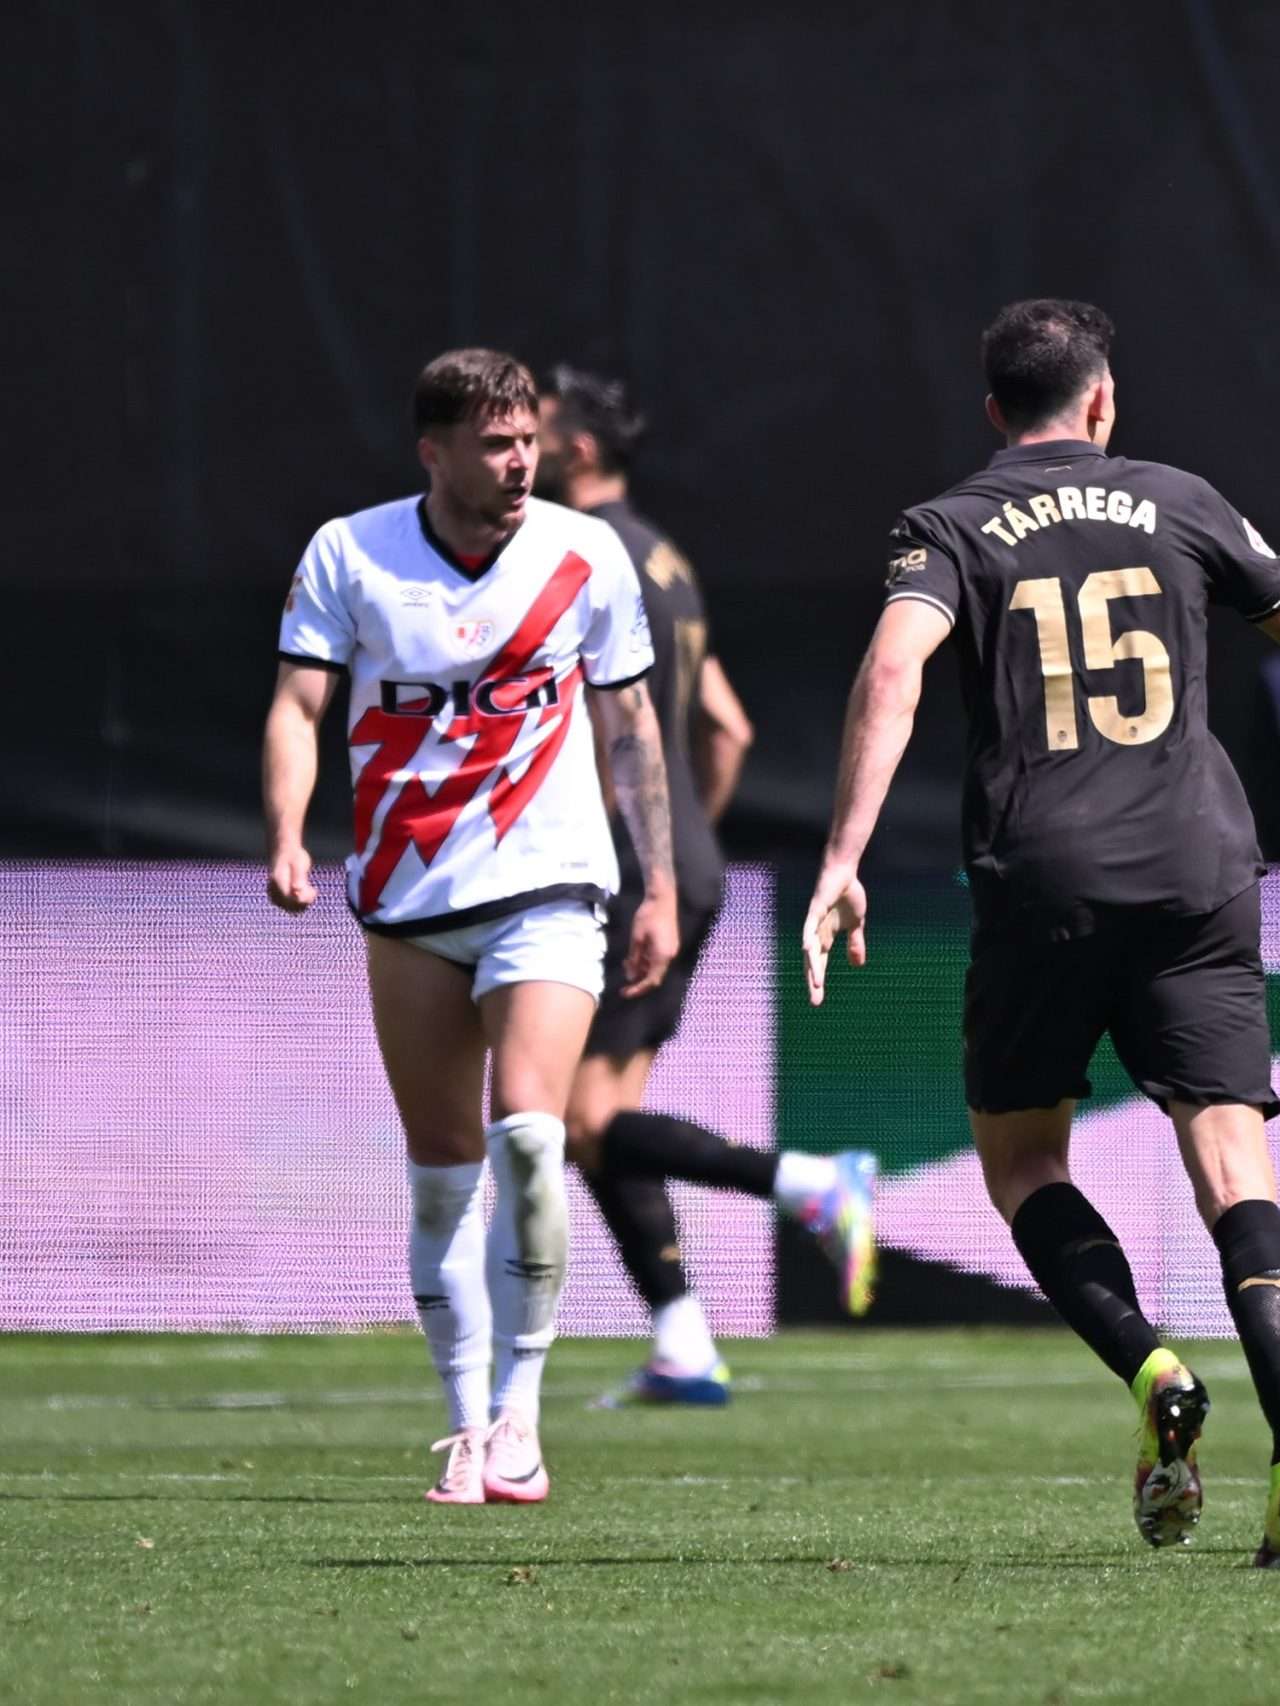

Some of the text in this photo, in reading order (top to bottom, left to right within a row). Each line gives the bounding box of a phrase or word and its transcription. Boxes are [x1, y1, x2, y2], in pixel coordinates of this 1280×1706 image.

[981, 486, 1158, 546] TÁRREGA
[1009, 566, 1175, 752] 15
[379, 677, 560, 718] DIGI
